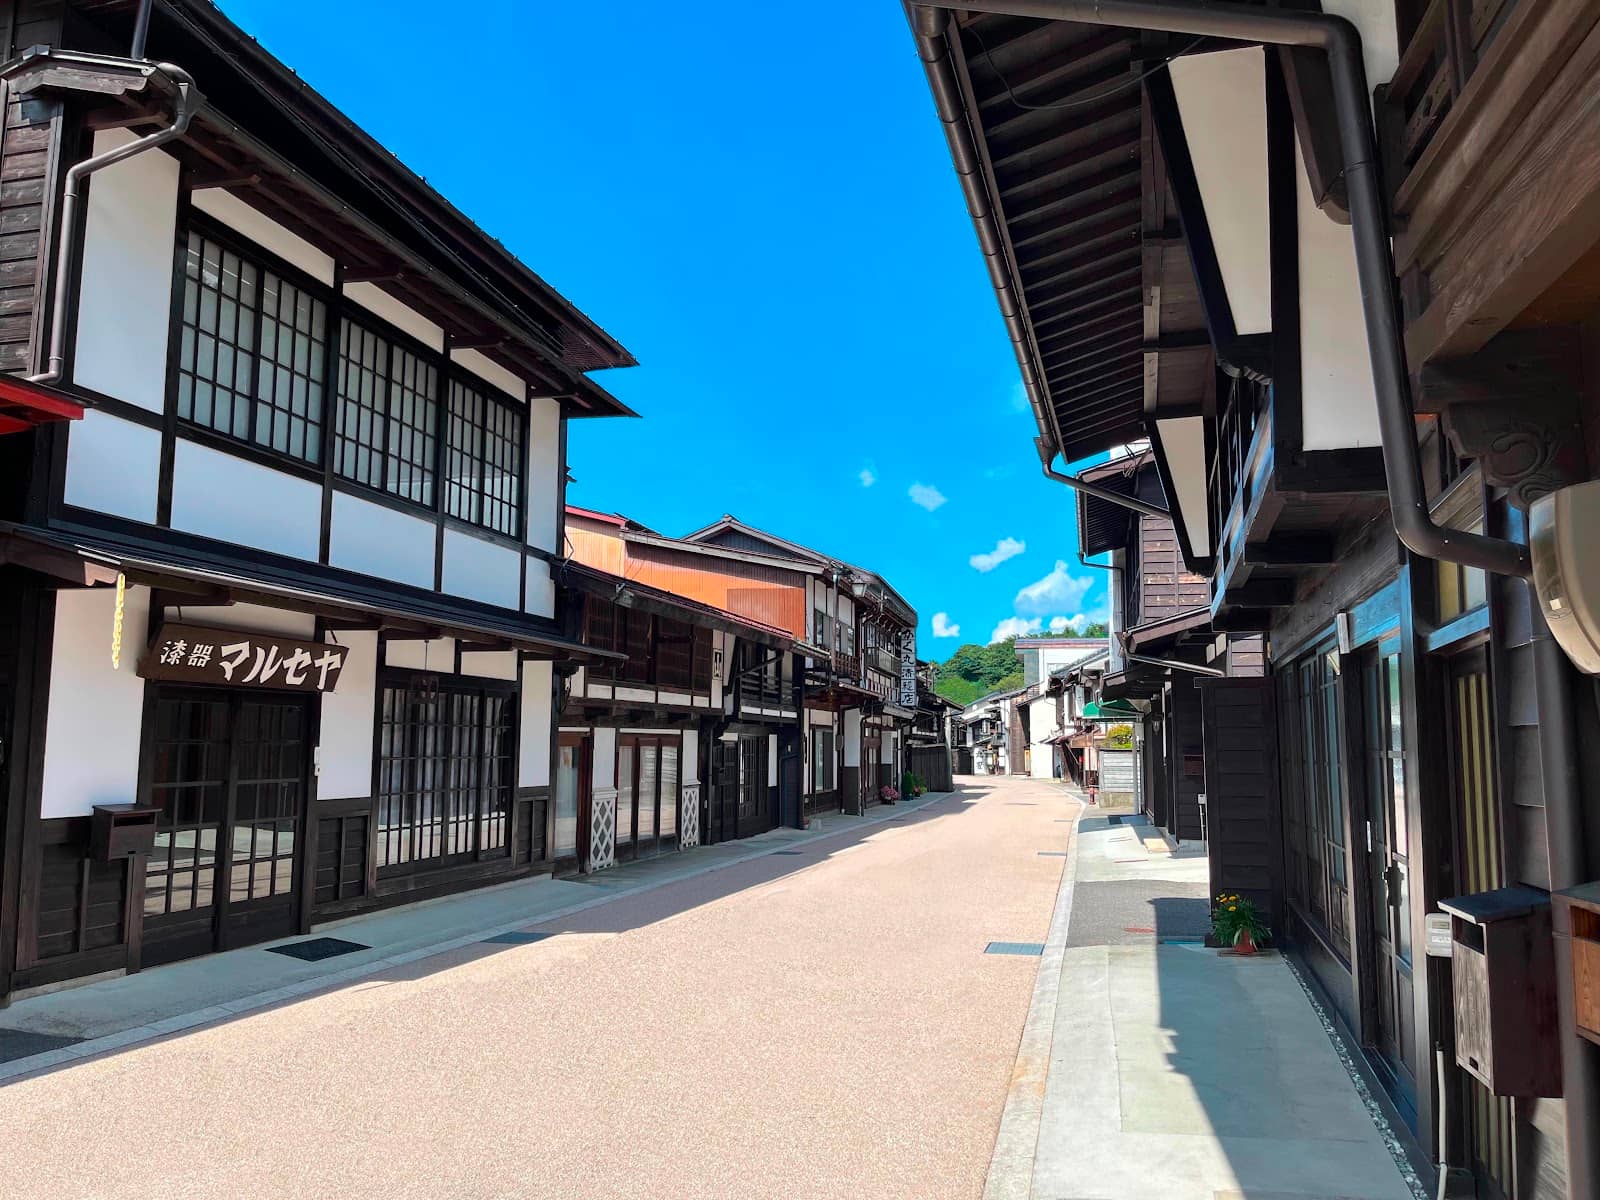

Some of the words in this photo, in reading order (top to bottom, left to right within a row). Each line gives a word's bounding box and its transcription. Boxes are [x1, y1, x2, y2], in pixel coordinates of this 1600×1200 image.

[160, 639, 214, 668] 漆器
[219, 640, 342, 690] マルセヤ
